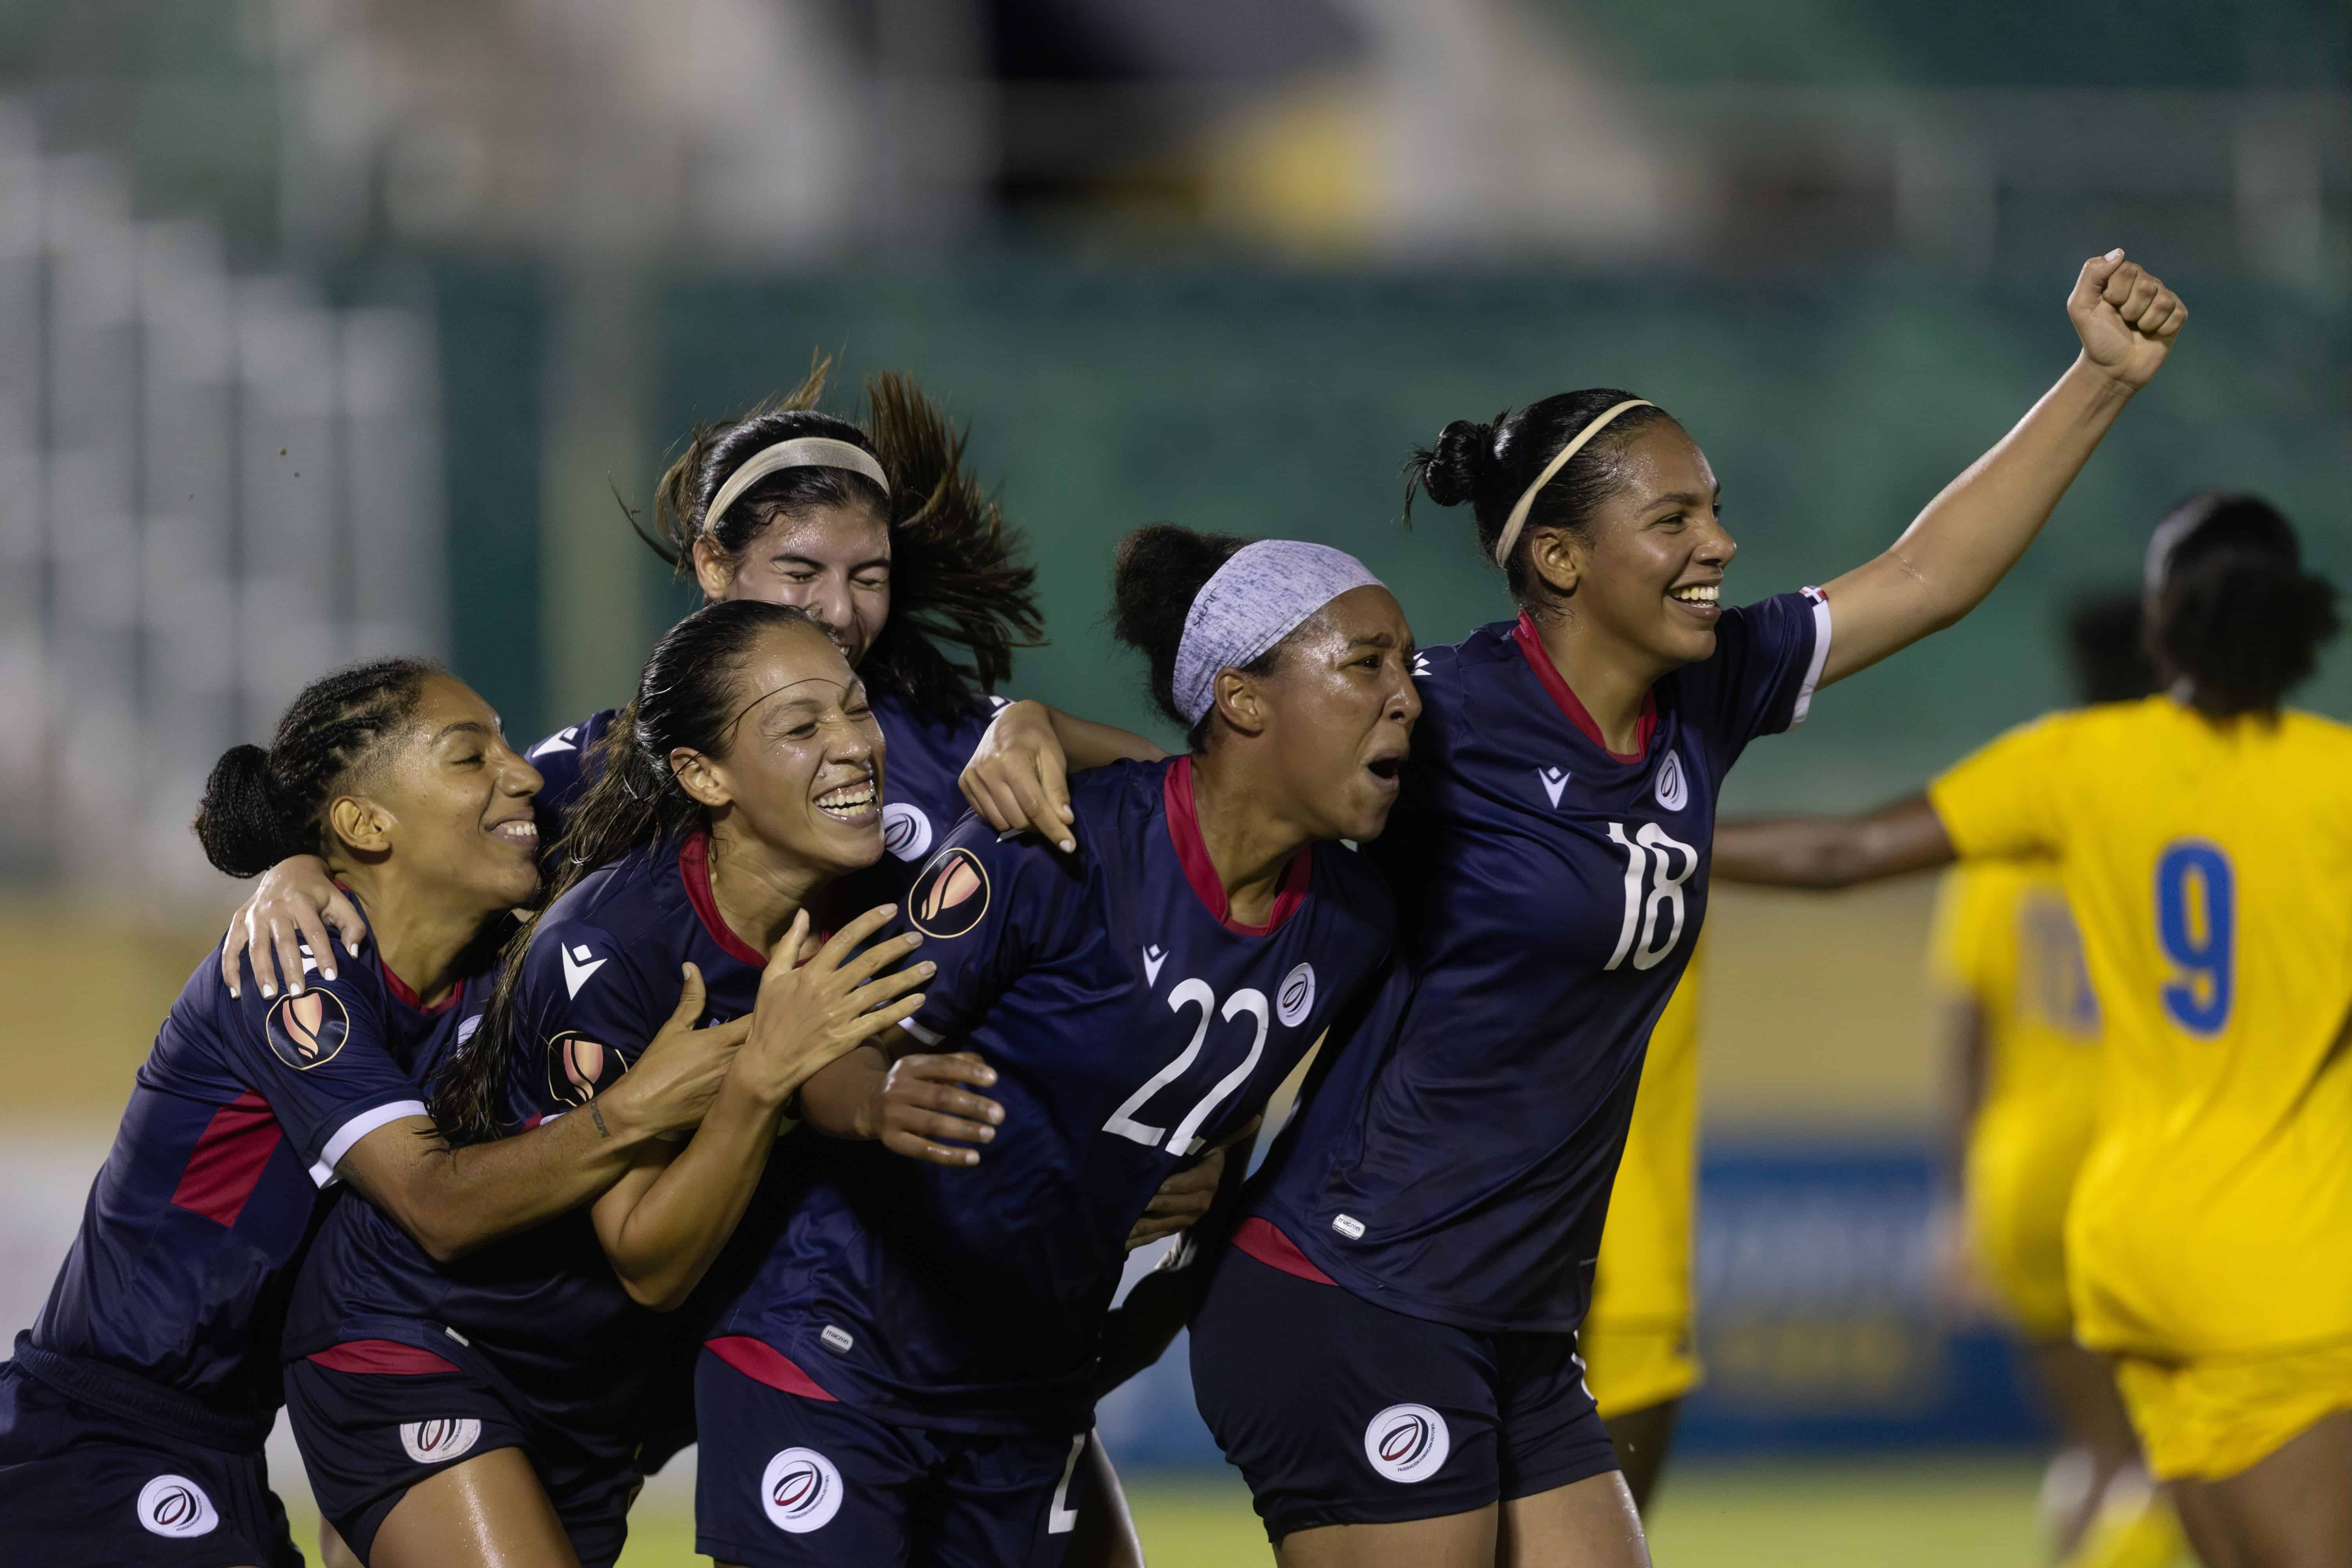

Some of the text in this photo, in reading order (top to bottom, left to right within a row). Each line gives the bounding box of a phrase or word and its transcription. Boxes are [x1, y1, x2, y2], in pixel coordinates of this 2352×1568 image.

[1602, 822, 1698, 971] 18
[2153, 836, 2237, 1041] 9
[1102, 978, 1269, 1157] 22
[1338, 1218, 1361, 1231] macron
